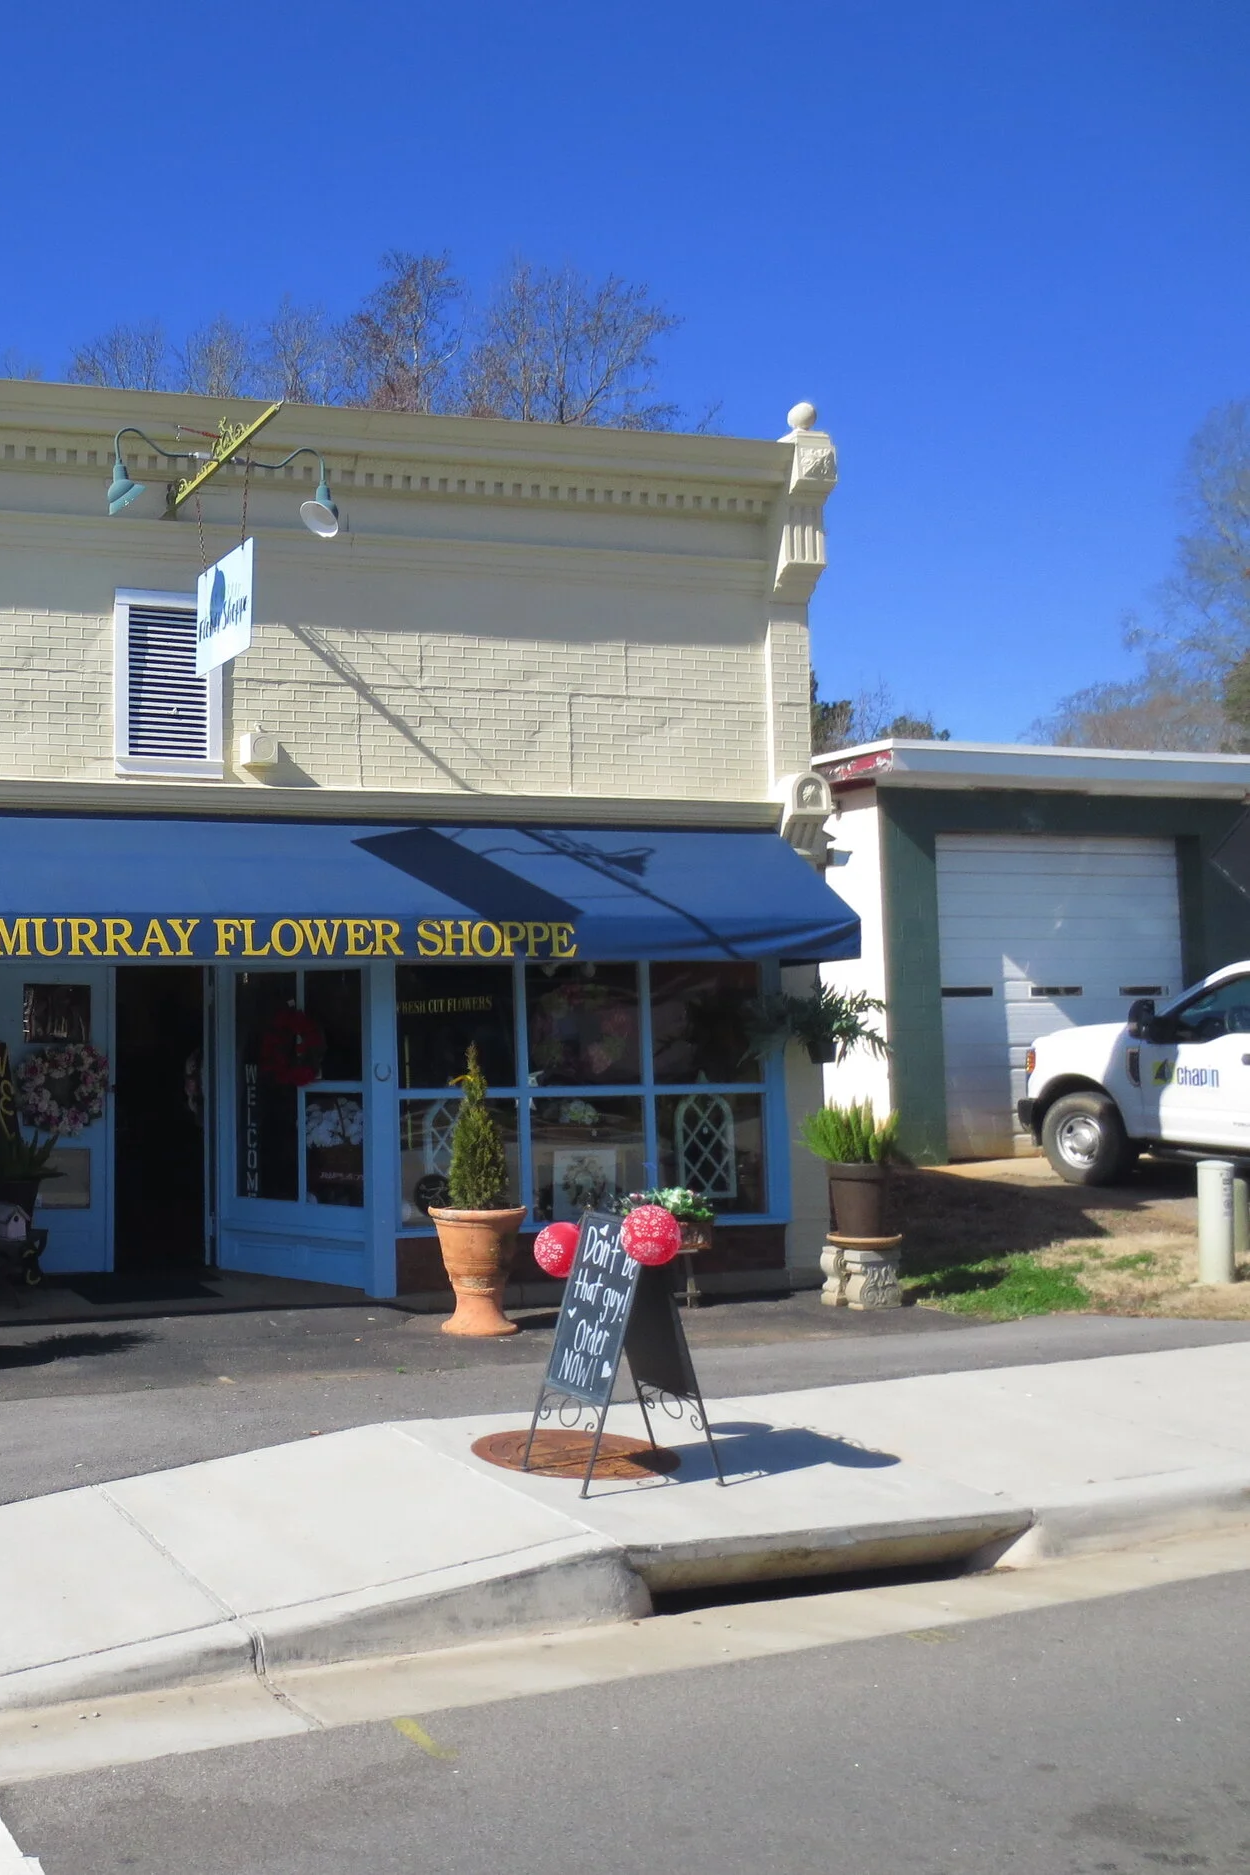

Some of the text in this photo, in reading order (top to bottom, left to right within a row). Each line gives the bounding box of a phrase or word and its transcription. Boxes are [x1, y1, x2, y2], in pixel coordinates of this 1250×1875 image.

[213, 918, 404, 957] FLOWER
[417, 919, 578, 957] SHOPPE
[428, 998, 445, 1014] CUT
[447, 995, 493, 1012] FLOWERS
[1176, 1065, 1220, 1088] chapin
[245, 1063, 259, 1198] WELCOM
[582, 1225, 620, 1274] Don't
[573, 1268, 631, 1324] that guy!
[573, 1318, 610, 1357] Order
[557, 1347, 599, 1392] NOW!
